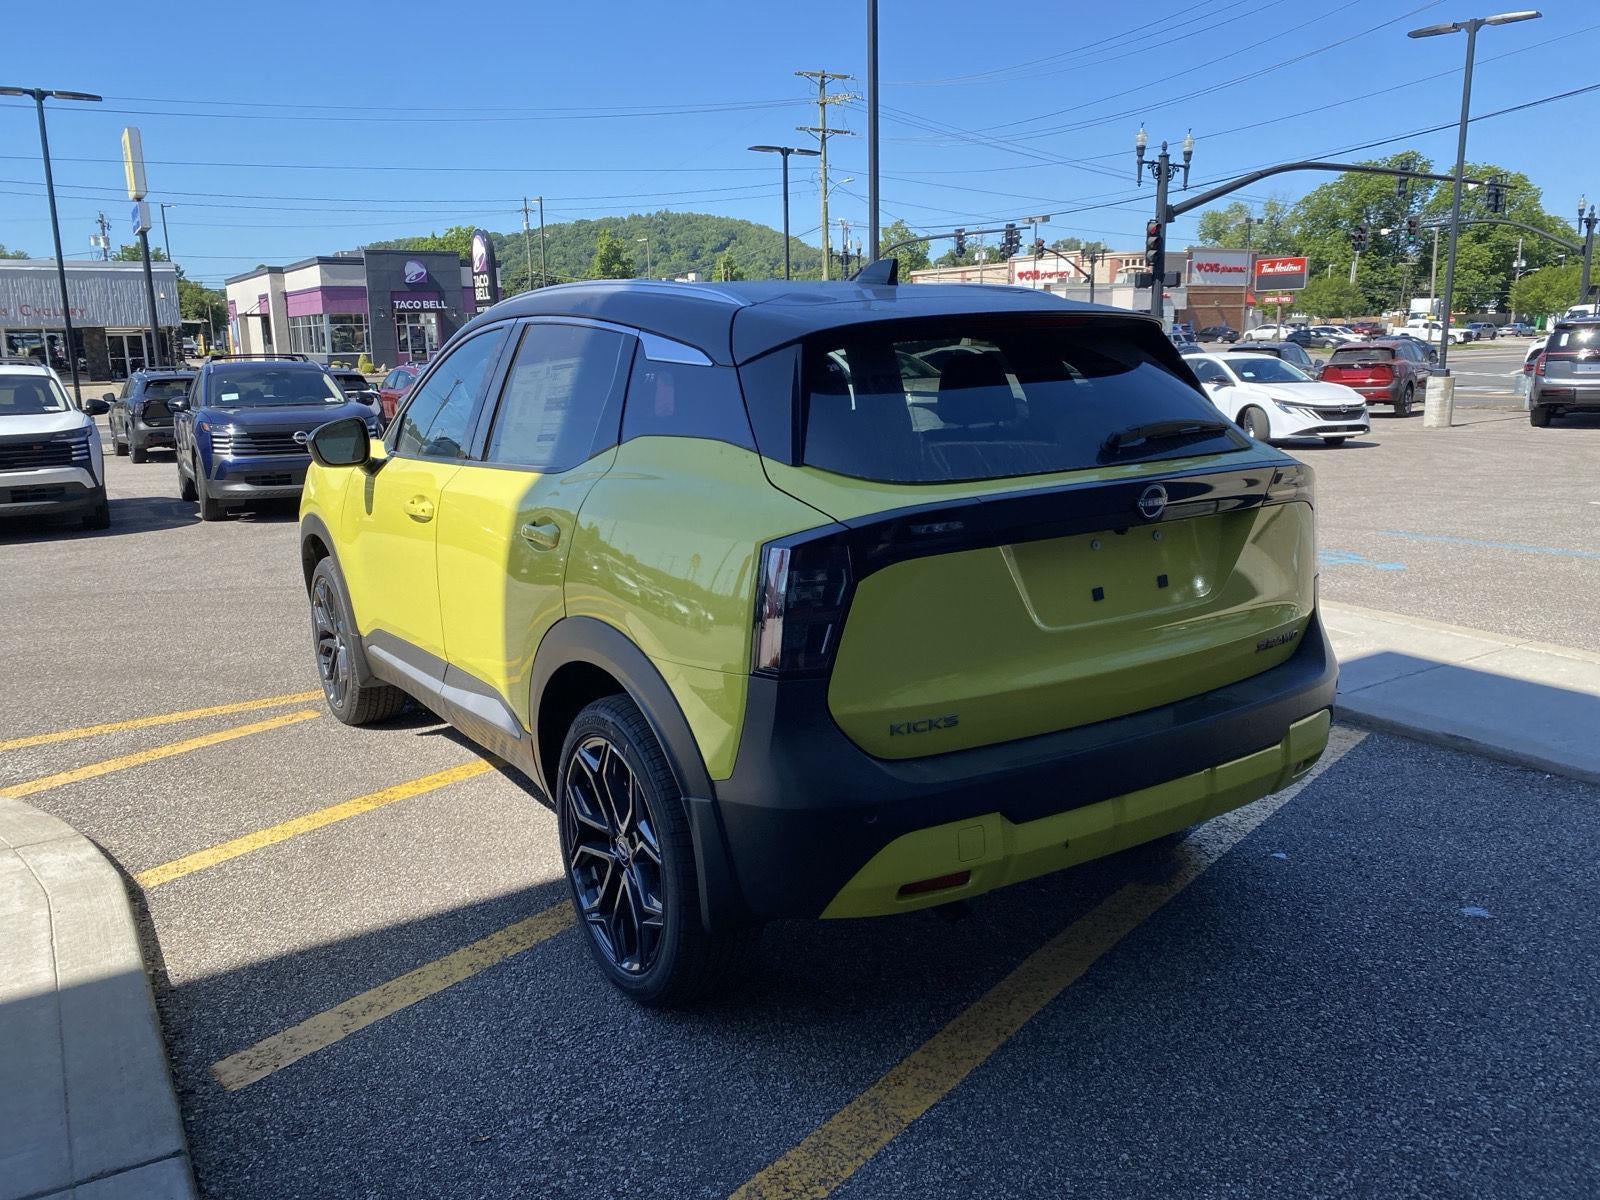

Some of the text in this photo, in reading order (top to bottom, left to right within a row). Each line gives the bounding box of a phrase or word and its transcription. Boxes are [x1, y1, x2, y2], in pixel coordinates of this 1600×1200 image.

[1203, 263, 1247, 274] CVS pharmac
[1261, 262, 1301, 274] Tim Hortons
[473, 274, 489, 287] TACO
[1024, 270, 1071, 281] CVS pharmacy
[475, 288, 491, 300] BELL
[394, 301, 448, 309] TACO BELL
[889, 714, 960, 736] KICKS
